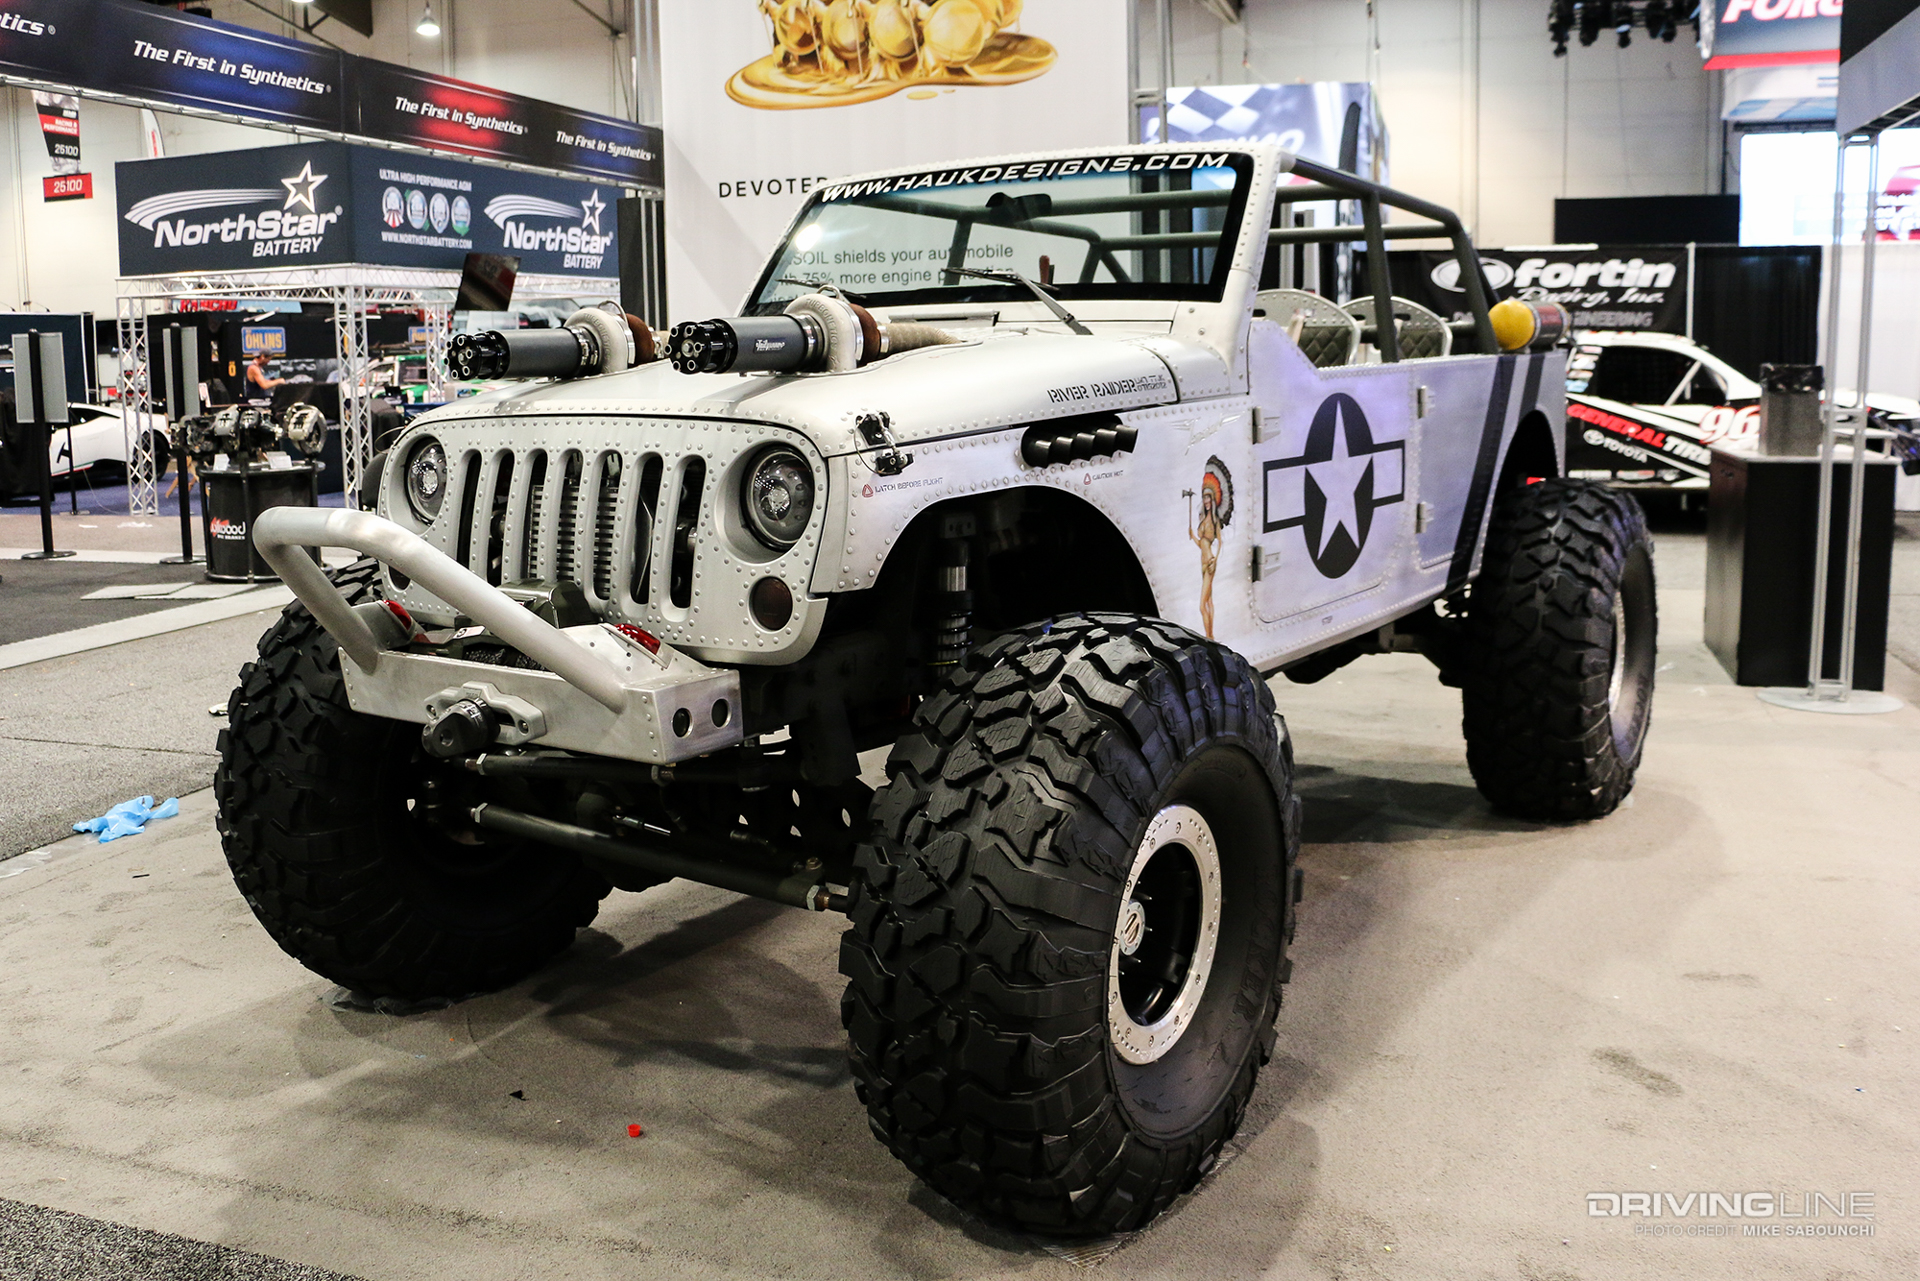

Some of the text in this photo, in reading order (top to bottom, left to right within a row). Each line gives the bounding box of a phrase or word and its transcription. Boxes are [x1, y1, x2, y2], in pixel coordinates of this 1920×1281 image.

[134, 40, 325, 95] The First in Synthetics
[395, 96, 524, 136] The First in Synthetics
[54, 143, 79, 156] 25100
[556, 131, 651, 161] The First in Synthetics
[53, 179, 83, 193] 25100
[379, 168, 400, 181] ULTRA
[400, 172, 416, 185] HIGH
[416, 174, 458, 190] PERFORMANCE
[154, 209, 338, 248] NorthStar
[503, 221, 609, 255] NorthStar
[252, 236, 324, 258] BATTERY
[834, 250, 886, 264] shields
[892, 252, 922, 268] your
[928, 244, 1014, 261] aumobile
[563, 253, 603, 269] BATTERY
[1513, 258, 1676, 288] fortin
[840, 273, 877, 285] more
[881, 269, 932, 286] engine
[1617, 287, 1665, 304] Inc.
[1047, 385, 1090, 404] RIVER
[1091, 379, 1138, 398] RAIDER
[1566, 404, 1667, 449] GENERAL
[1699, 404, 1761, 445] 96
[1603, 437, 1649, 464] TOYOTA
[874, 477, 944, 493] LATCH BEFORE FLIGHT
